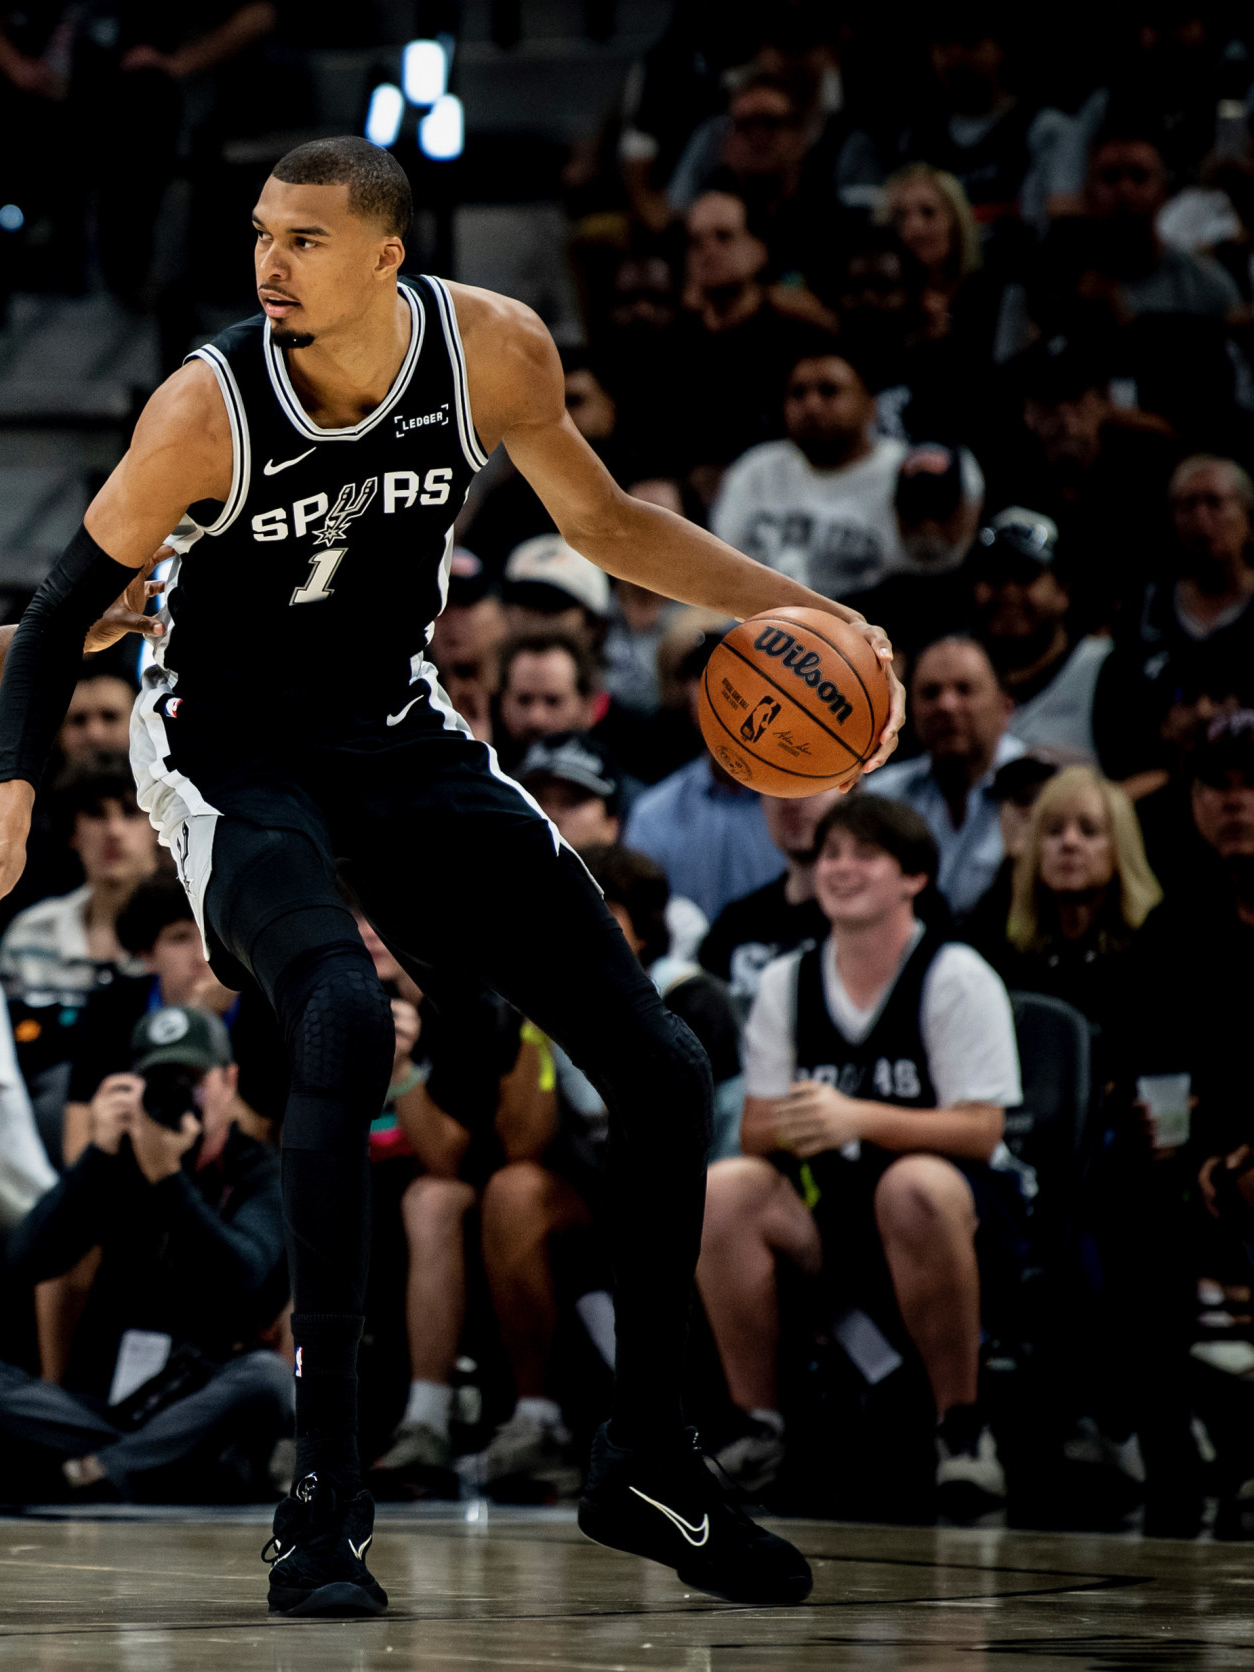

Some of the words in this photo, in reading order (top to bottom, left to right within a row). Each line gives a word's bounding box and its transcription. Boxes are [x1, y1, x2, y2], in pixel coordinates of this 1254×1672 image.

[402, 411, 443, 430] LEDGER
[289, 547, 348, 606] 1
[754, 625, 854, 727] Wilson
